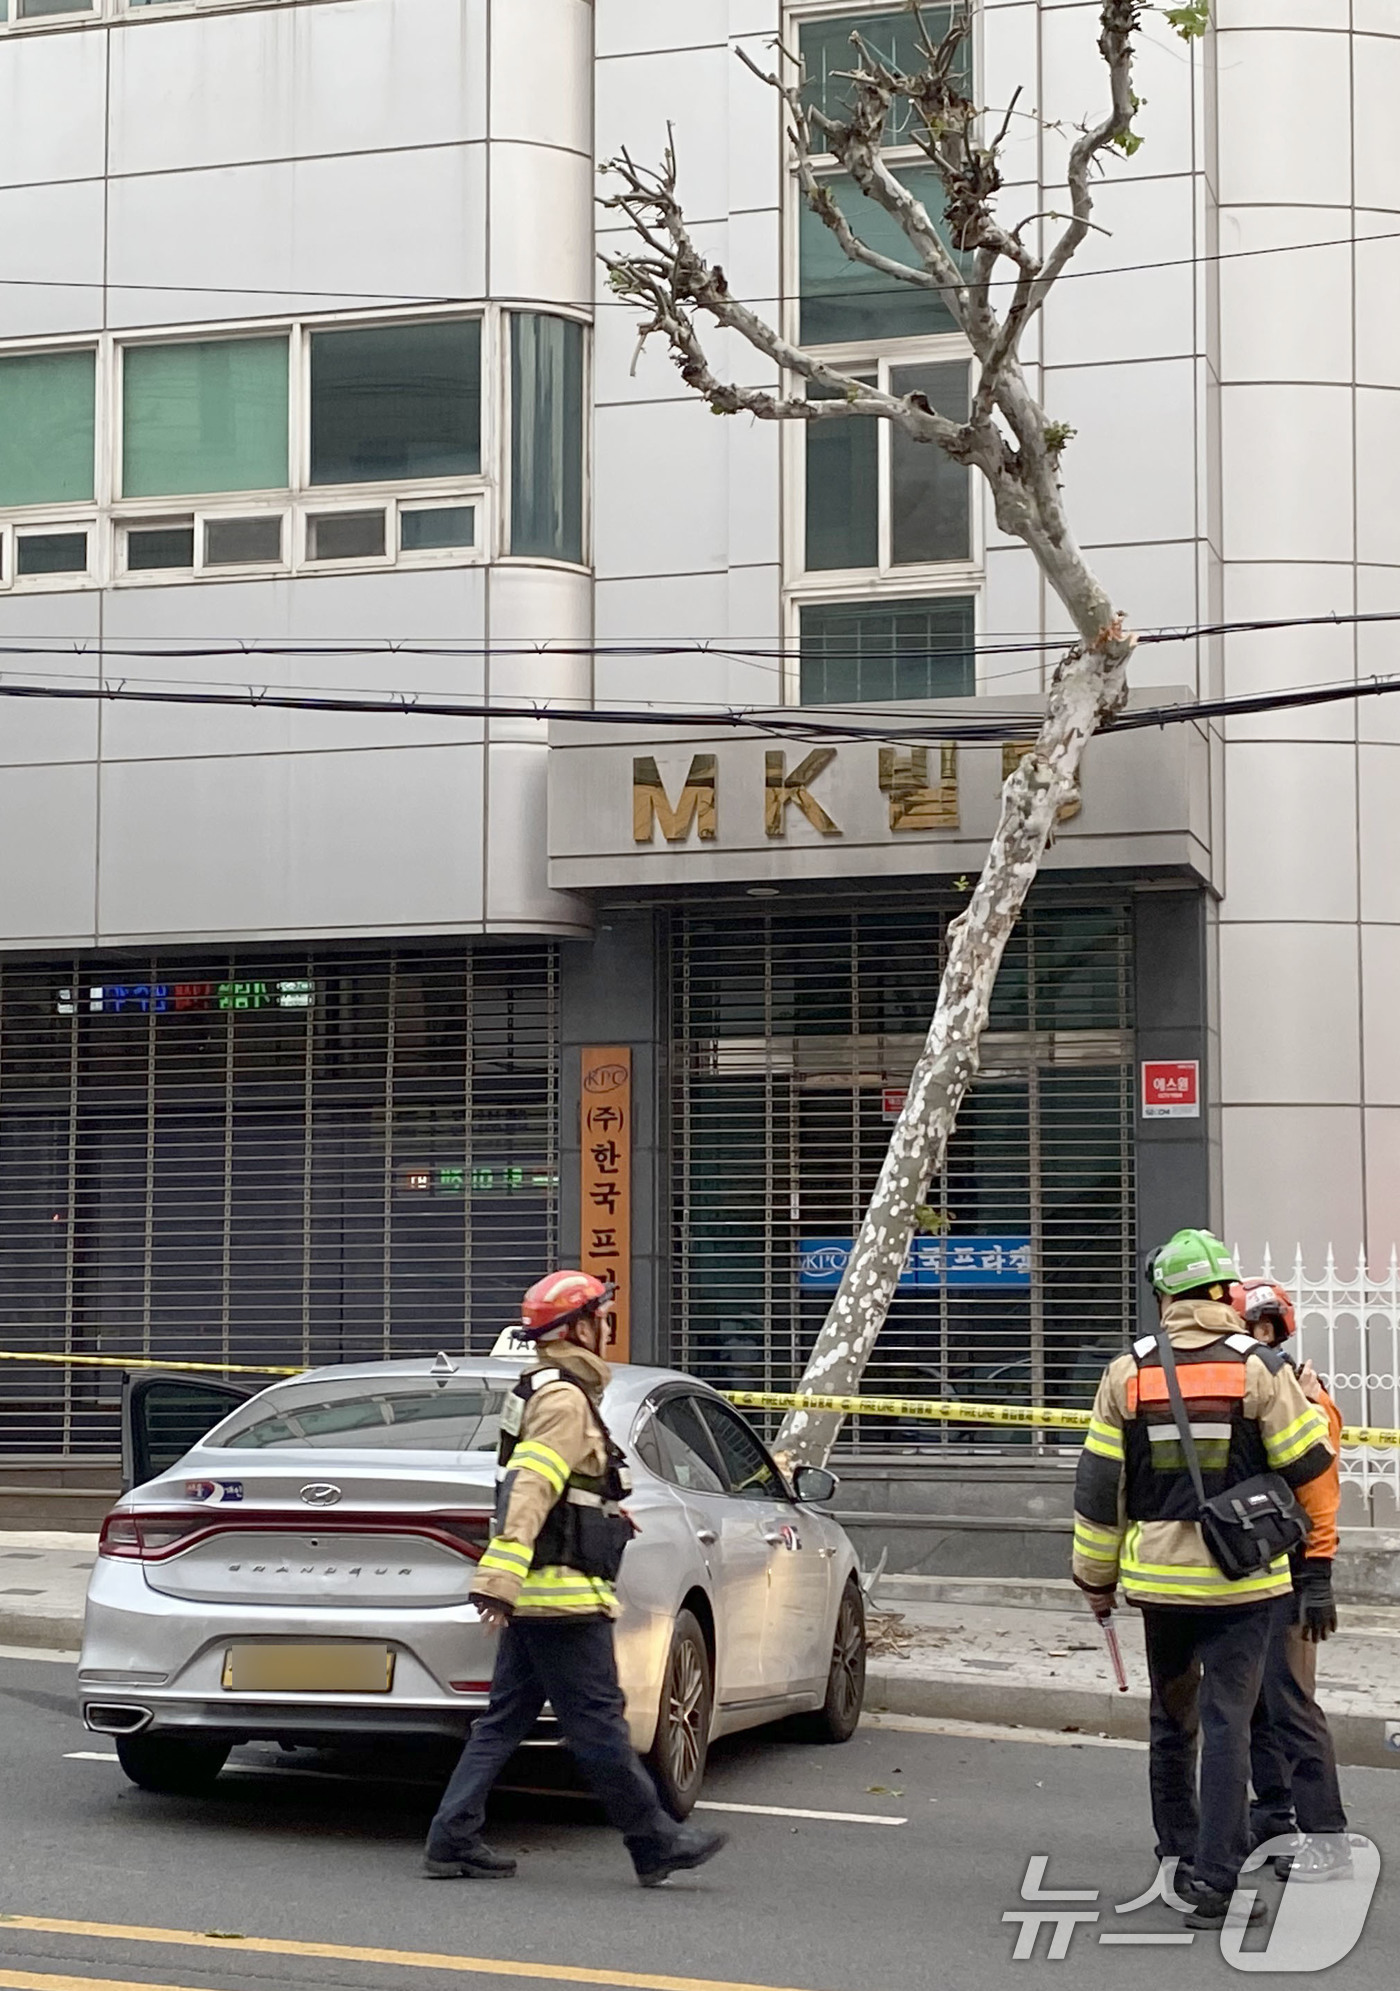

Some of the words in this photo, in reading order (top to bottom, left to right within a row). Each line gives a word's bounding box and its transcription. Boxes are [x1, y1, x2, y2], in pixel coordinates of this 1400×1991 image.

[633, 740, 1081, 842] MK빌
[588, 1069, 626, 1087] KPC
[507, 1337, 538, 1350] TA
